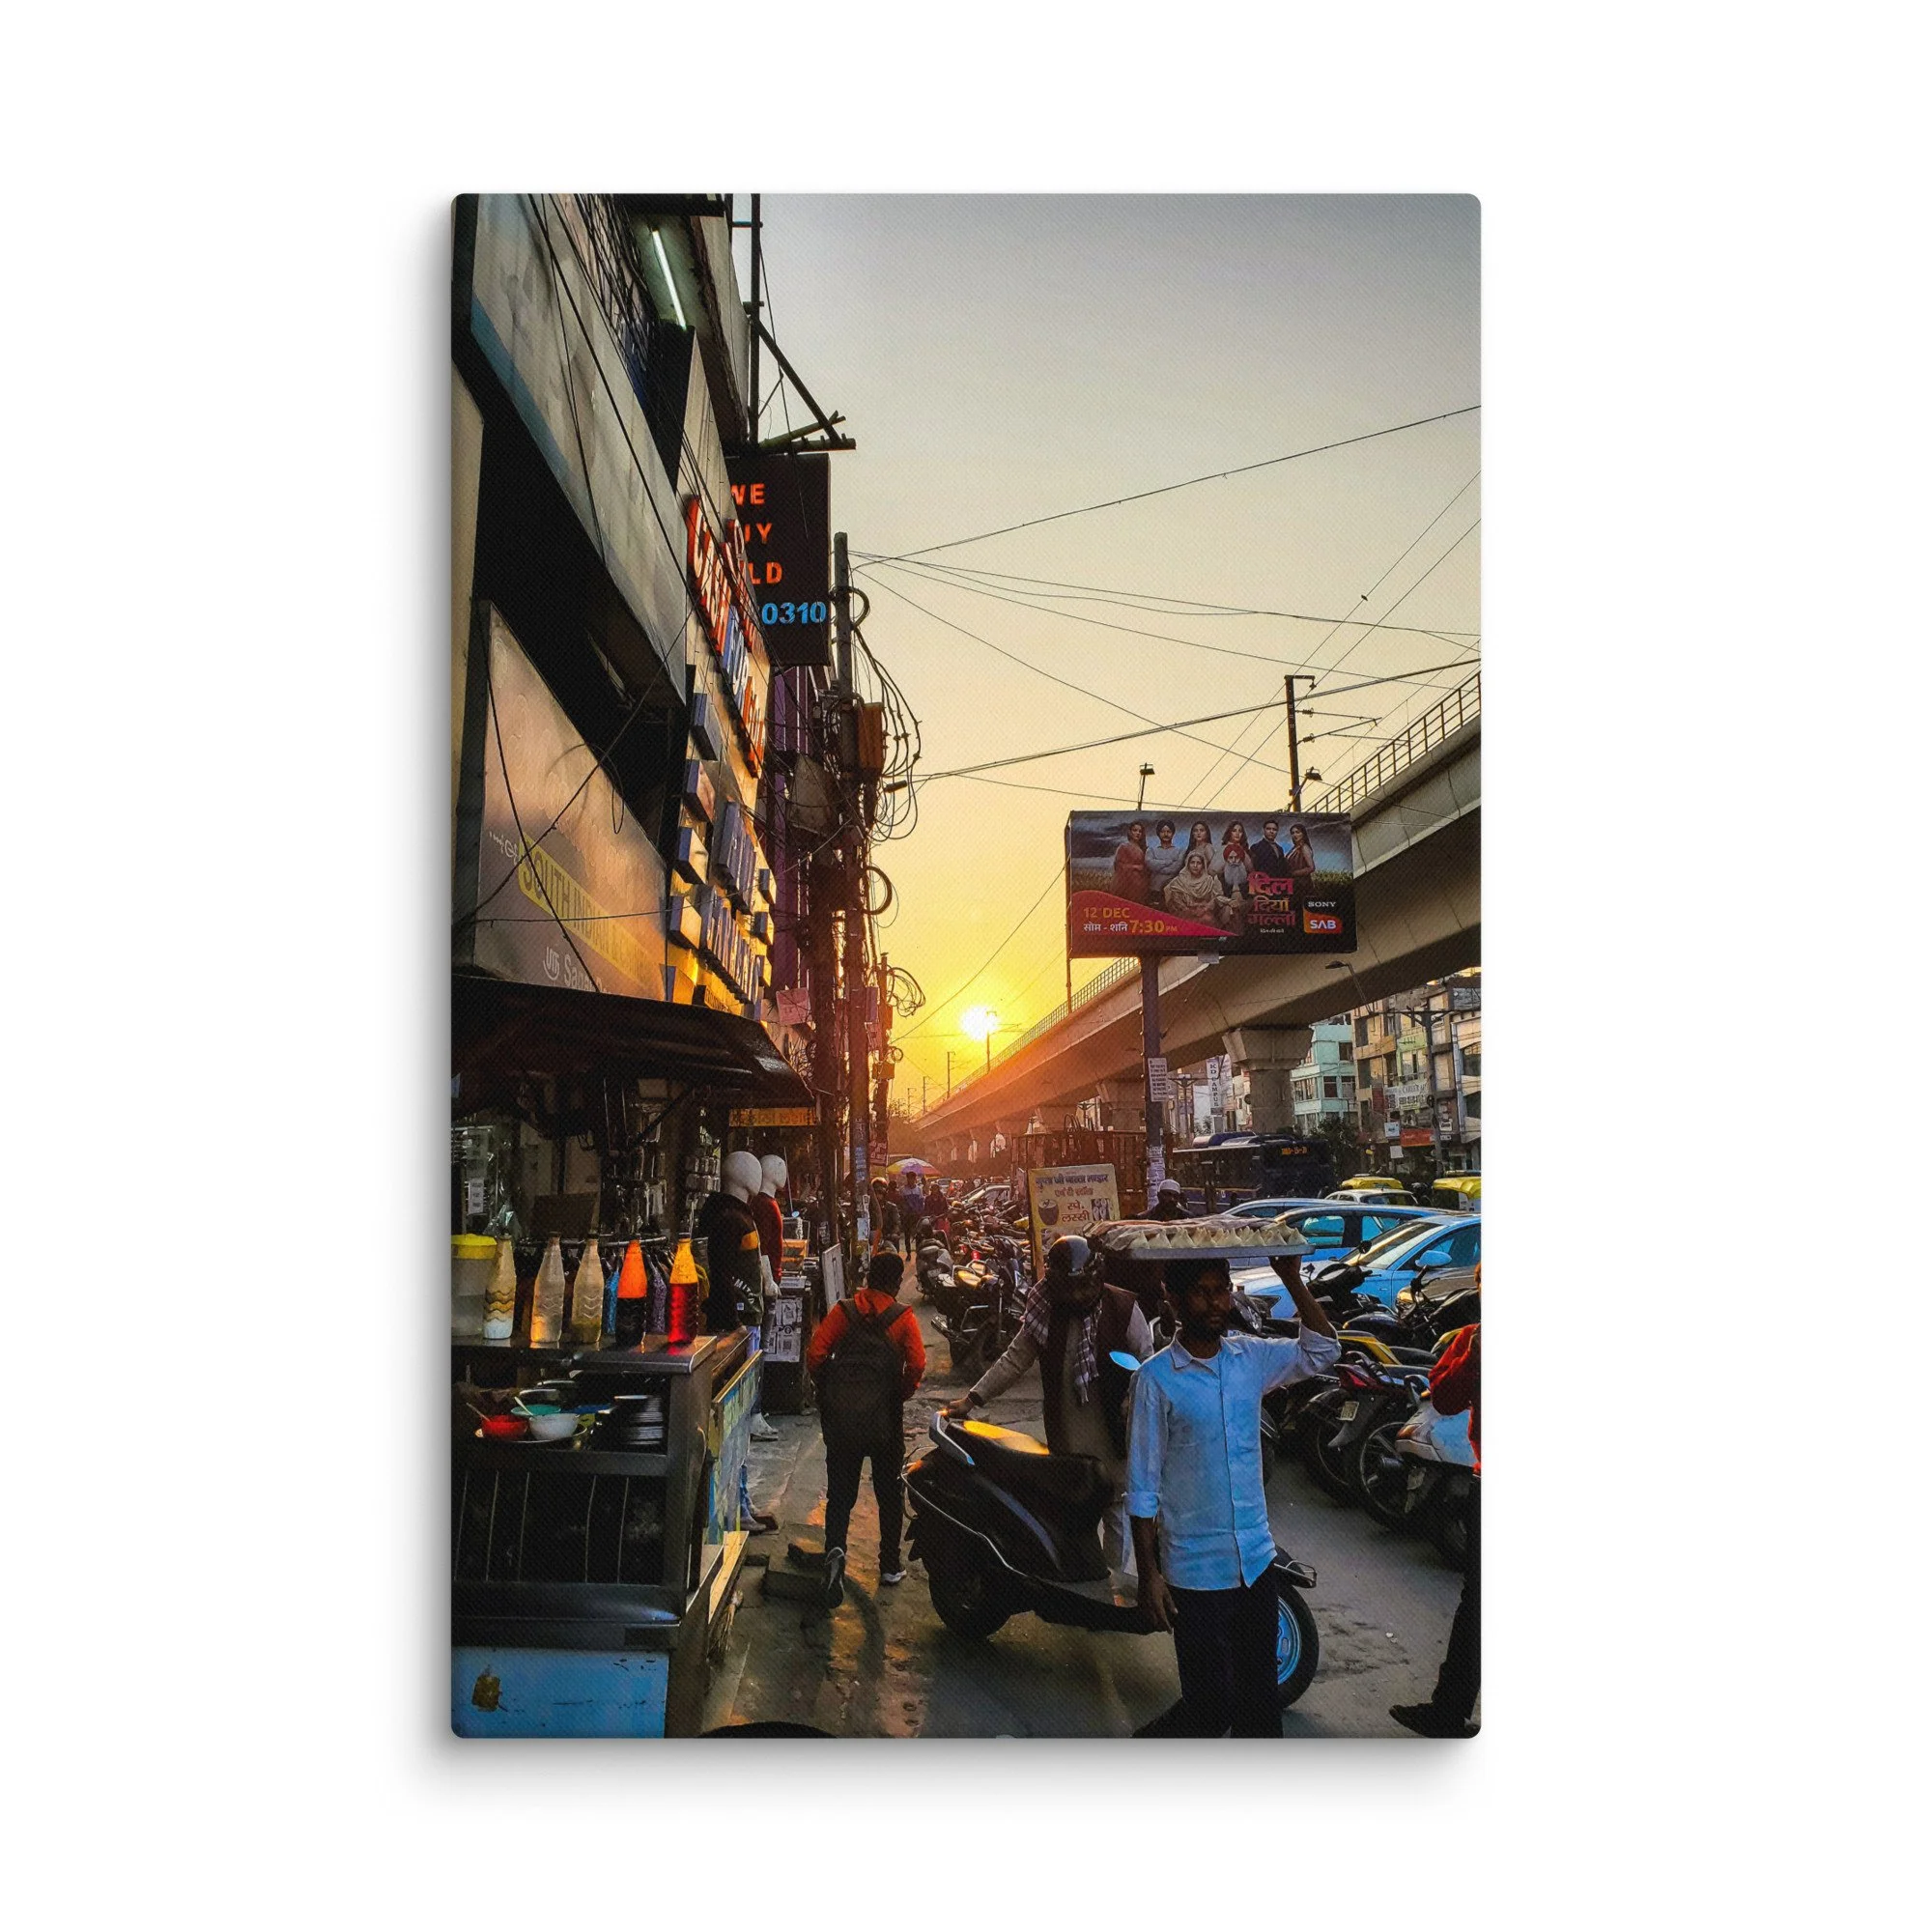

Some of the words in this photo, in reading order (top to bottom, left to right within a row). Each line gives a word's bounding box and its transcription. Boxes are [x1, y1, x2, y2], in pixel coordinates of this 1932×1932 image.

[523, 850, 571, 914] SOUTH
[1247, 870, 1294, 896] दिल
[1084, 908, 1098, 919] 12
[1102, 908, 1130, 919] DEC
[1084, 922, 1101, 932] सोम
[1110, 921, 1129, 932] शनि
[1310, 920, 1338, 929] SAB
[1062, 1209, 1090, 1222] लस्सी
